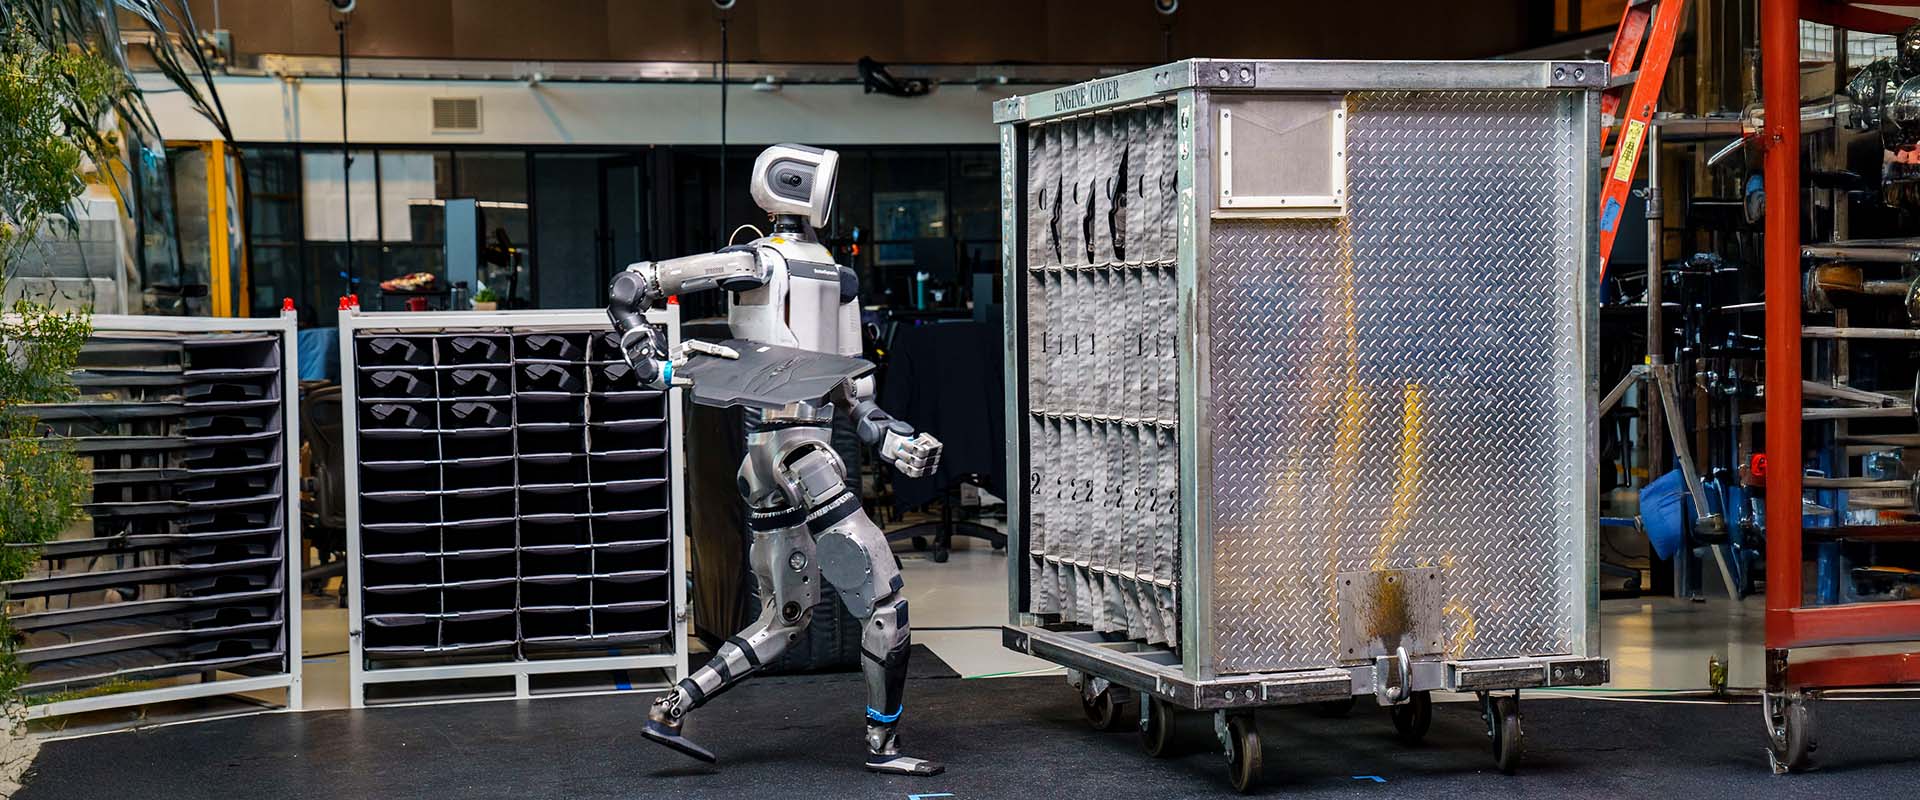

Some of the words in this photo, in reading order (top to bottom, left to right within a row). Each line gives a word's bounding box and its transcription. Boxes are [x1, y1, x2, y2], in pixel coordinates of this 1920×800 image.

[1054, 87, 1086, 113] ENGINE
[1090, 79, 1119, 105] COVER
[1031, 472, 1041, 495] 2
[1085, 479, 1094, 502] 2
